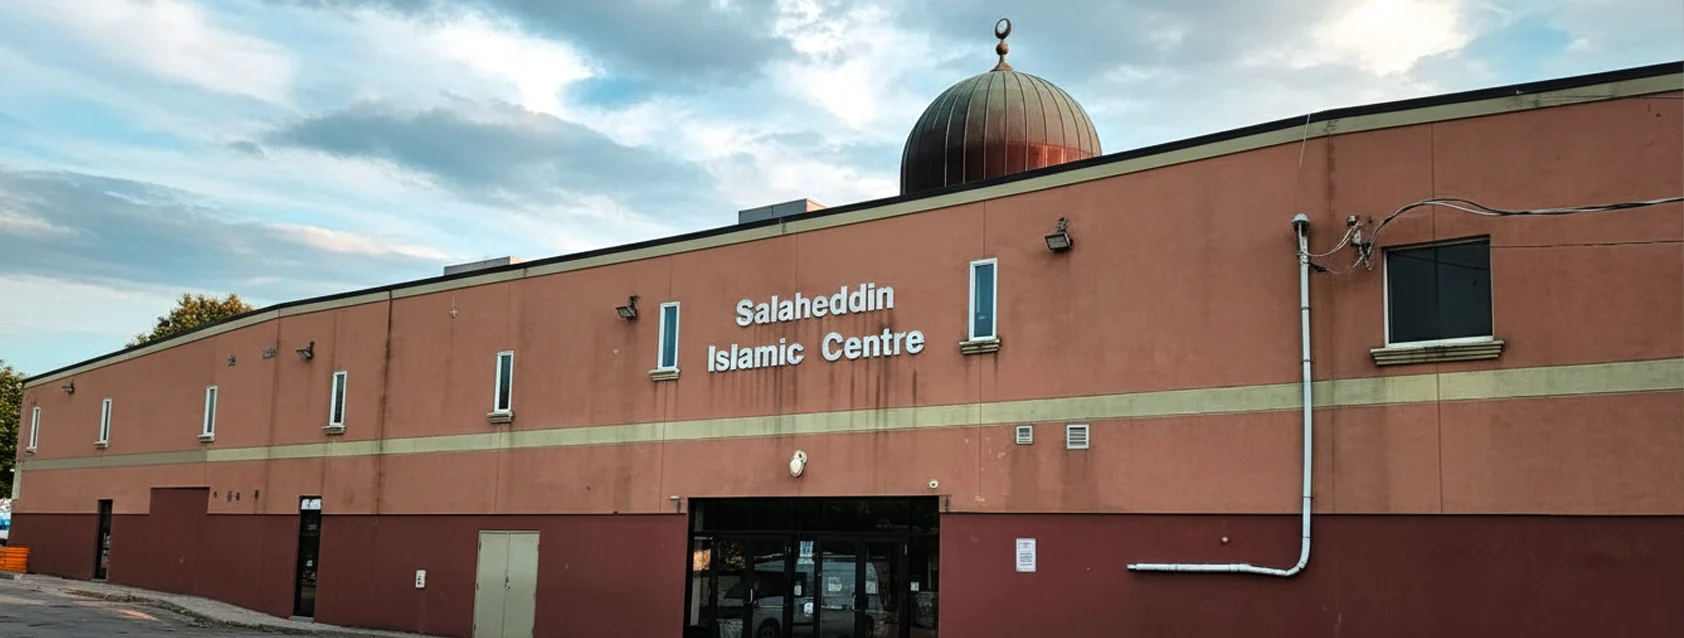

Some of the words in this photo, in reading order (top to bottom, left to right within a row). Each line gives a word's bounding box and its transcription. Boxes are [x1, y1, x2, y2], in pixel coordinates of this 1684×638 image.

[736, 282, 894, 327] Salaheddin
[707, 337, 804, 372] Islamic
[822, 327, 925, 362] Centre
